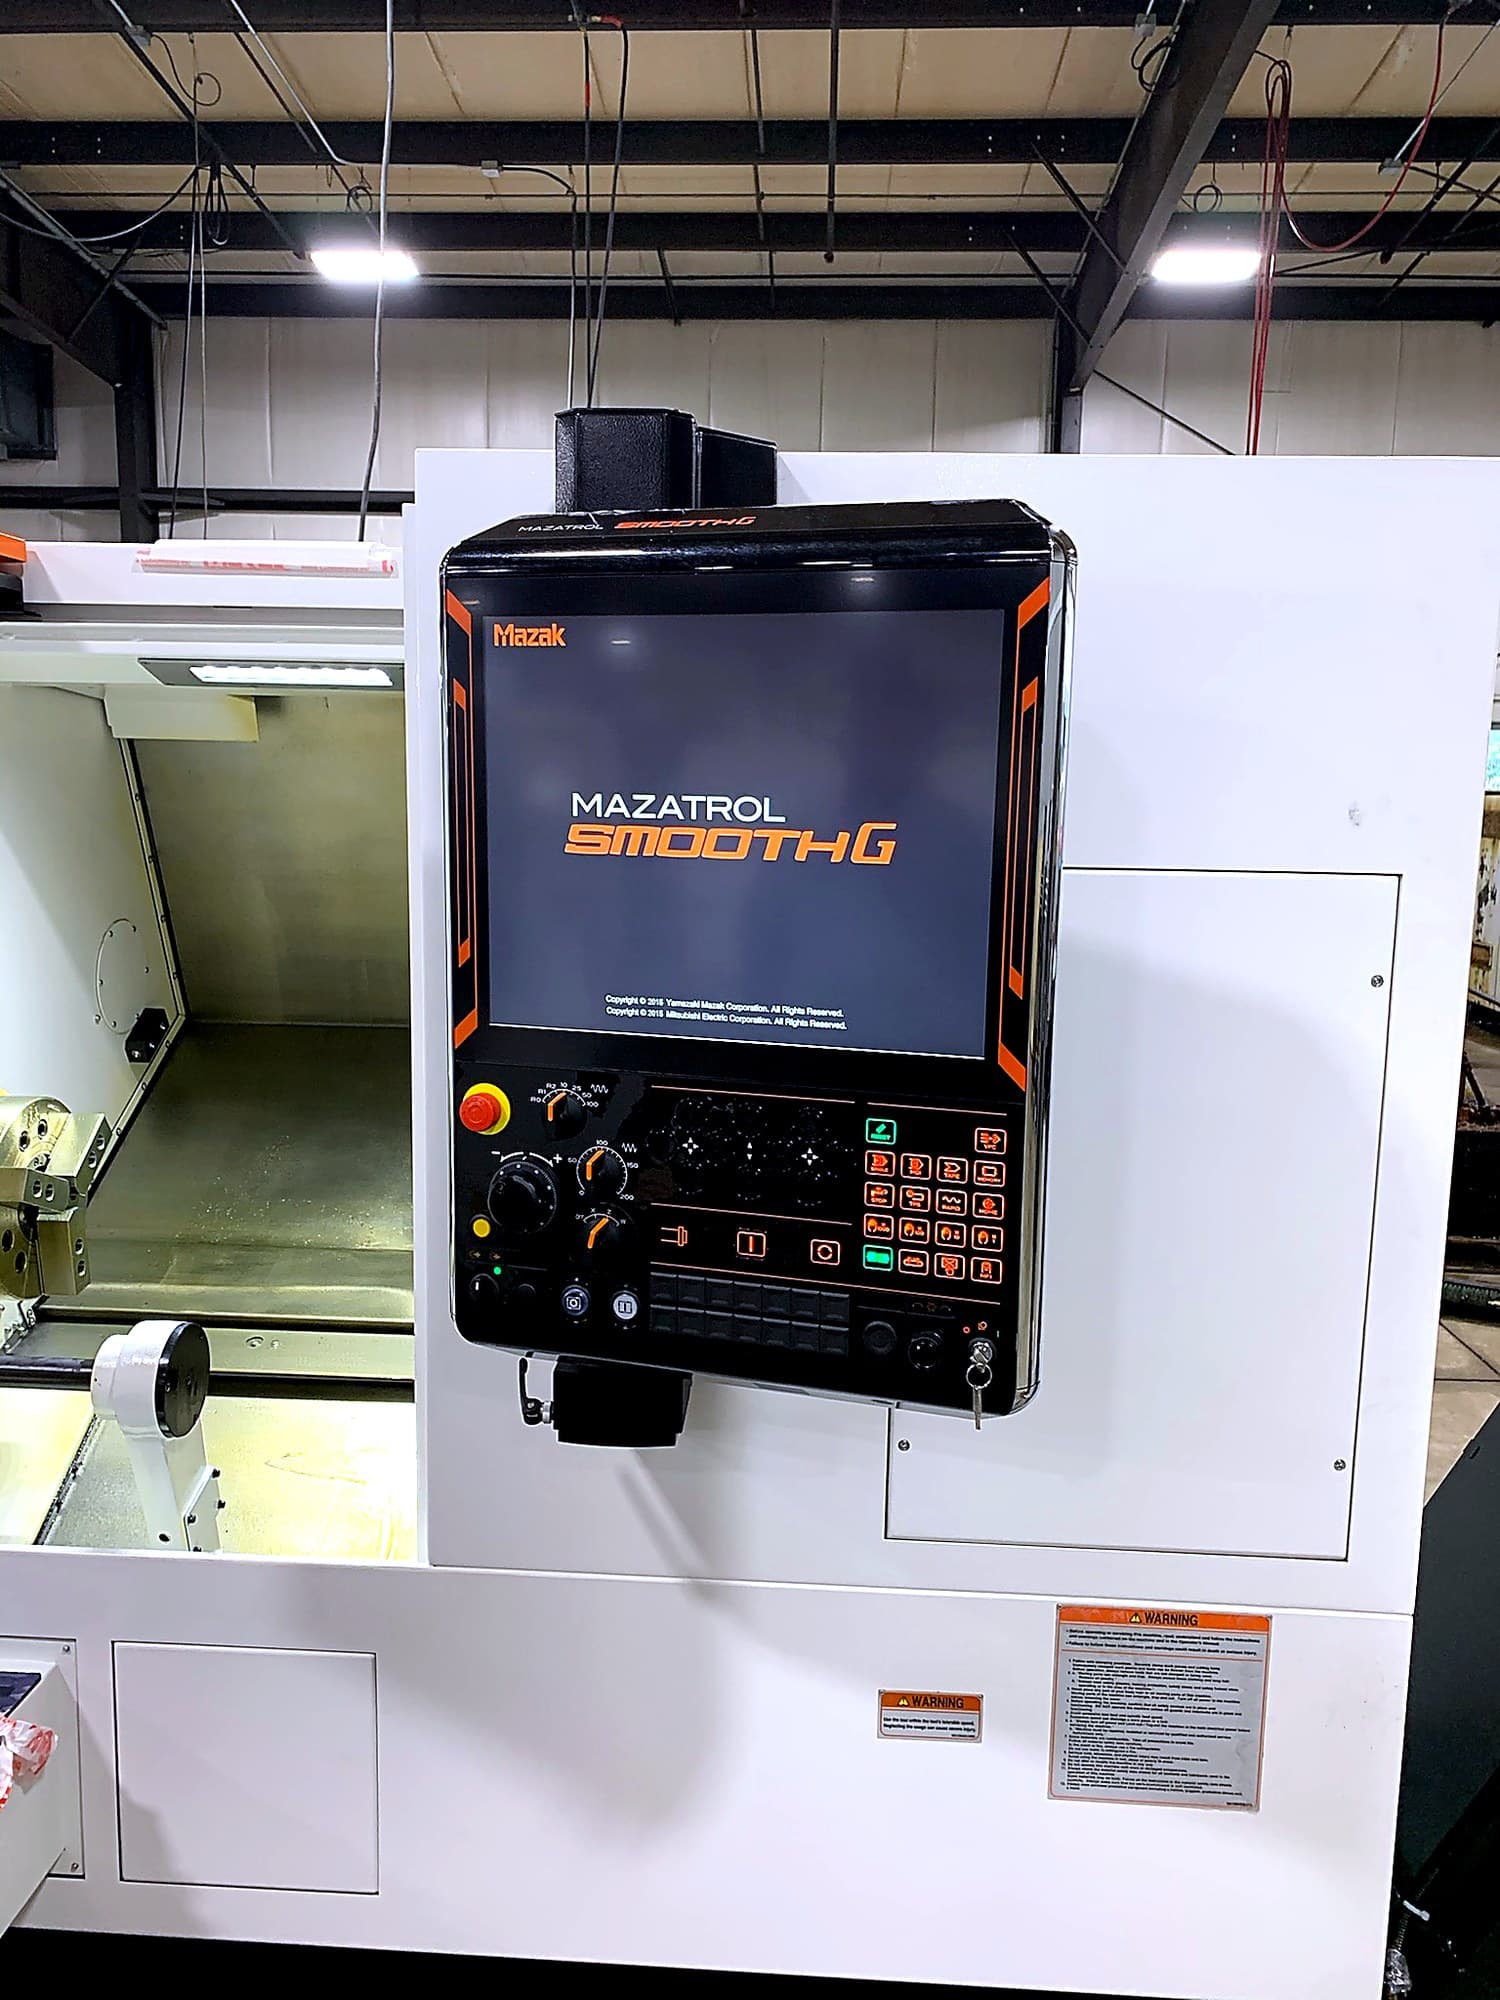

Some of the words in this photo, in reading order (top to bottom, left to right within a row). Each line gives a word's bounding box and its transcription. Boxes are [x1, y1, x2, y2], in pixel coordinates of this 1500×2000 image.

[518, 523, 604, 533] MAZATROL
[493, 623, 567, 647] Mazak
[571, 792, 786, 823] MAZATROL
[605, 994, 638, 1006] Copyright
[606, 1006, 639, 1018] Copyright
[1144, 1613, 1199, 1626] WARNING
[912, 1695, 964, 1709] WARNING
